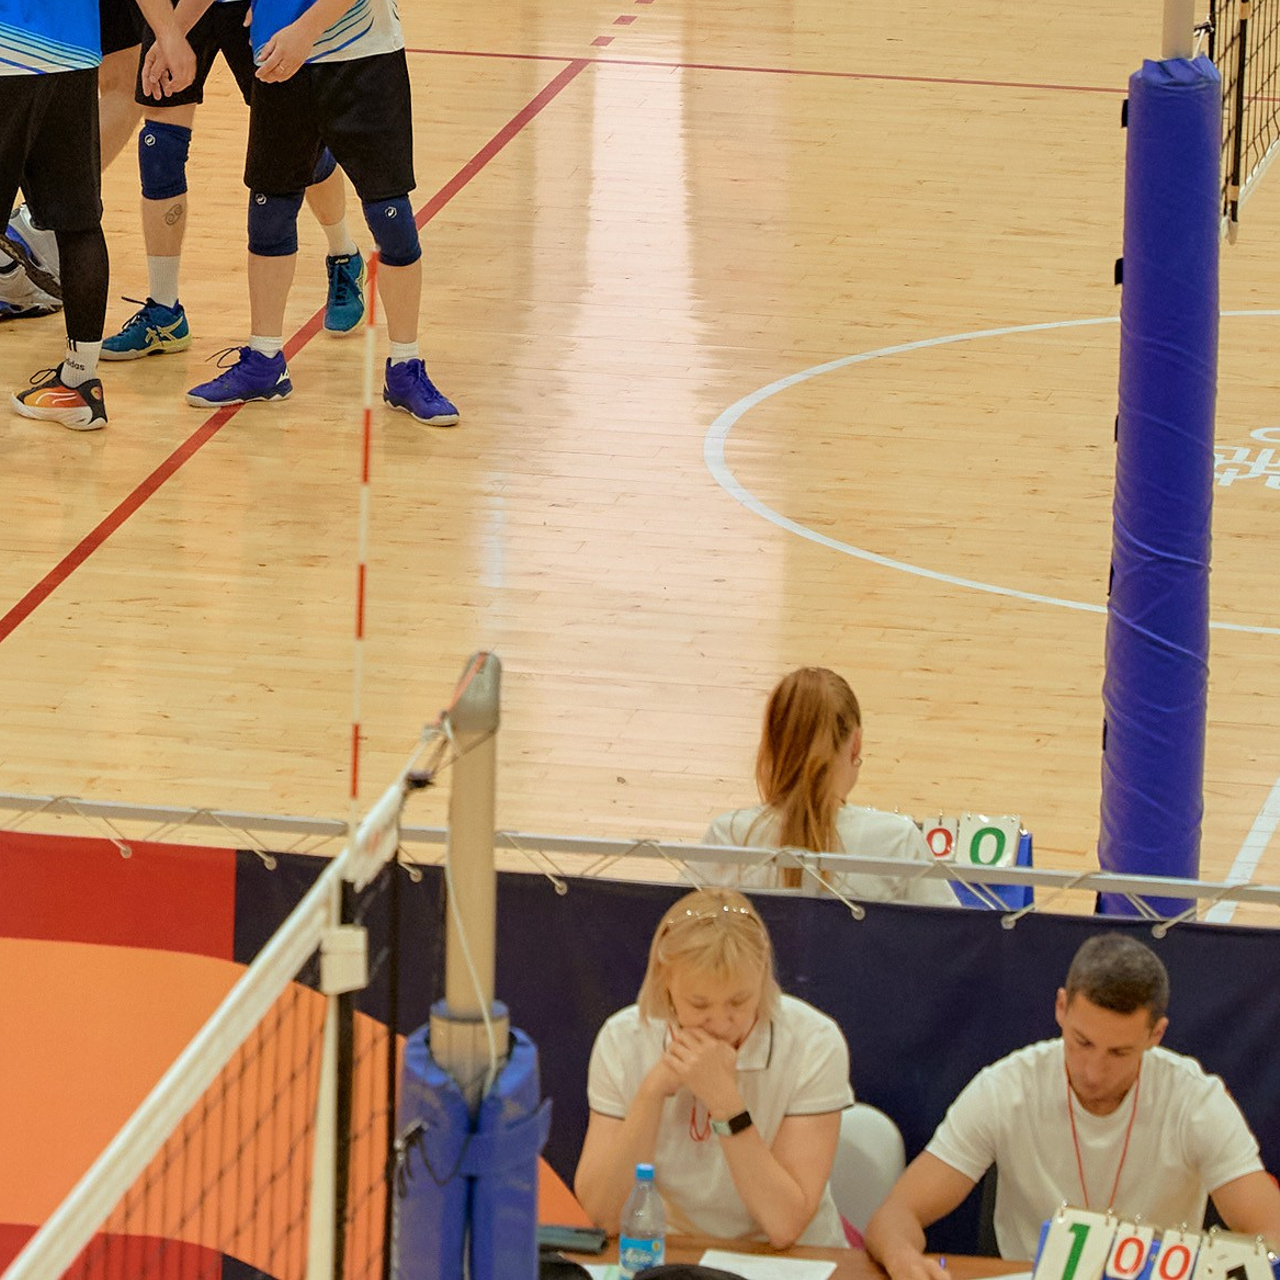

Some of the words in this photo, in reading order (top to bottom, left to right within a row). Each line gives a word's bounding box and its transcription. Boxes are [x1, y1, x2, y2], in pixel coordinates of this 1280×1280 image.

[970, 827, 1007, 866] 0
[1061, 1223, 1091, 1280] 1
[1113, 1237, 1145, 1274] 0
[1158, 1245, 1191, 1280] 0
